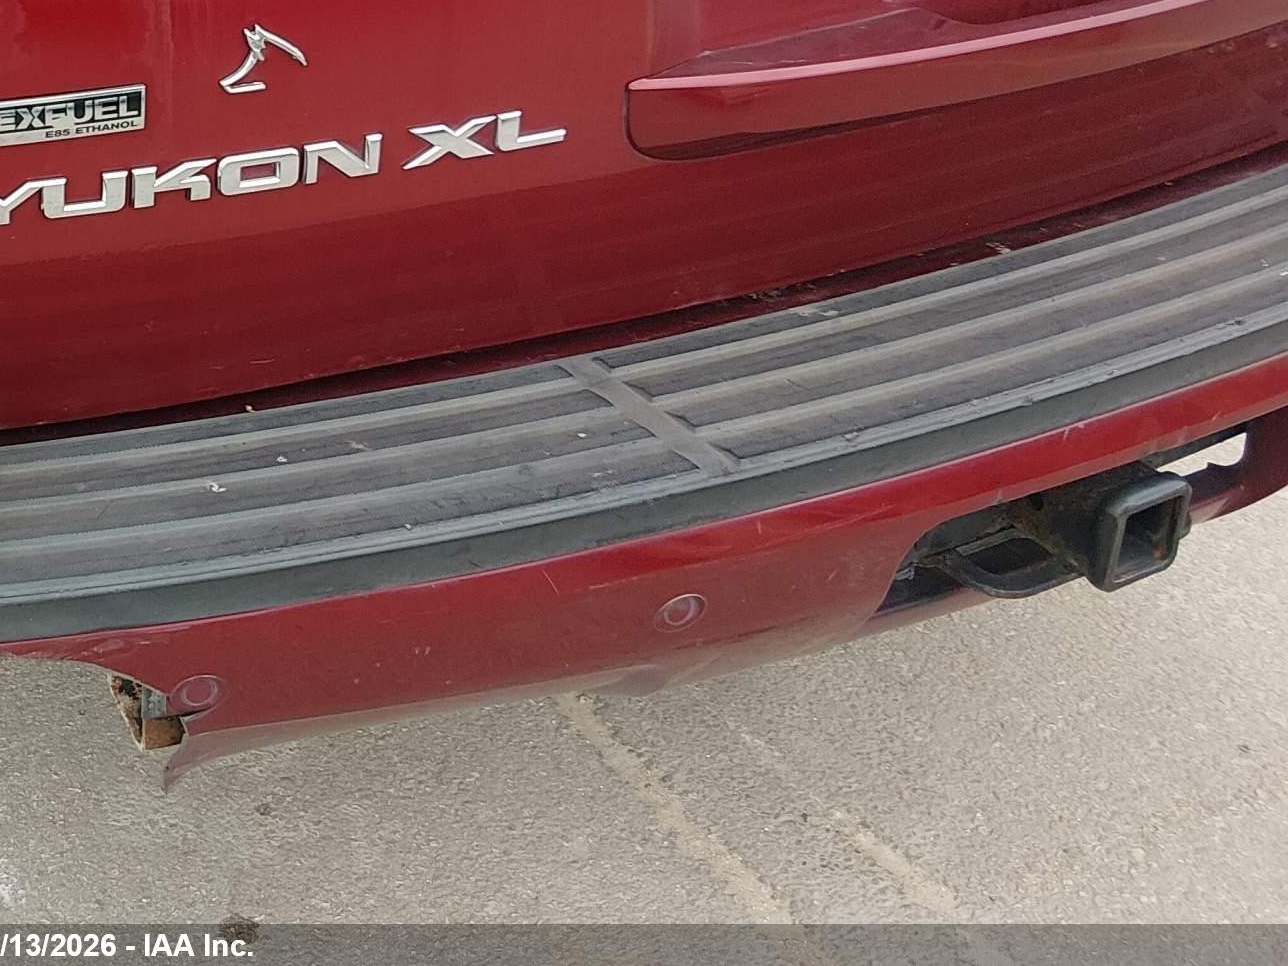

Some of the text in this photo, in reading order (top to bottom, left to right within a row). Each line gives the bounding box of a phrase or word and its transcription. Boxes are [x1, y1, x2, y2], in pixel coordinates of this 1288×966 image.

[45, 119, 138, 139] E85 ETHANOL
[402, 110, 567, 171] XL
